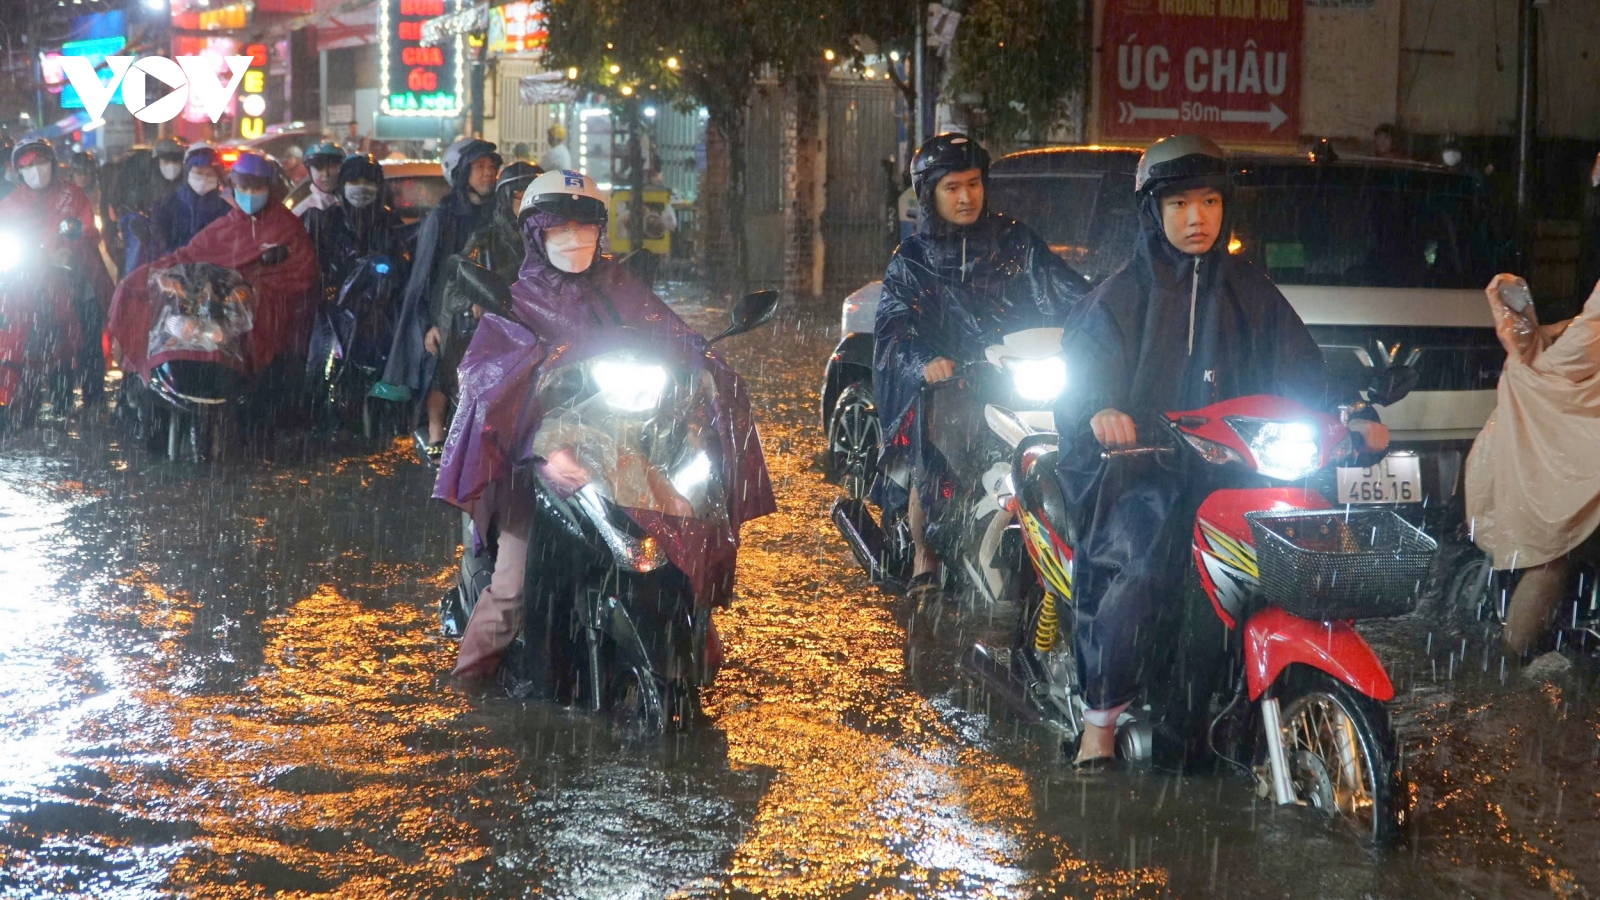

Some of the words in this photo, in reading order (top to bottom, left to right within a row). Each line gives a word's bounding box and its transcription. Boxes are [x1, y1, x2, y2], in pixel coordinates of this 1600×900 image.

[1118, 33, 1170, 91] ÚC
[1185, 39, 1287, 96] CHÂU
[1181, 101, 1220, 121] 50m
[1349, 481, 1412, 501] 466.16
